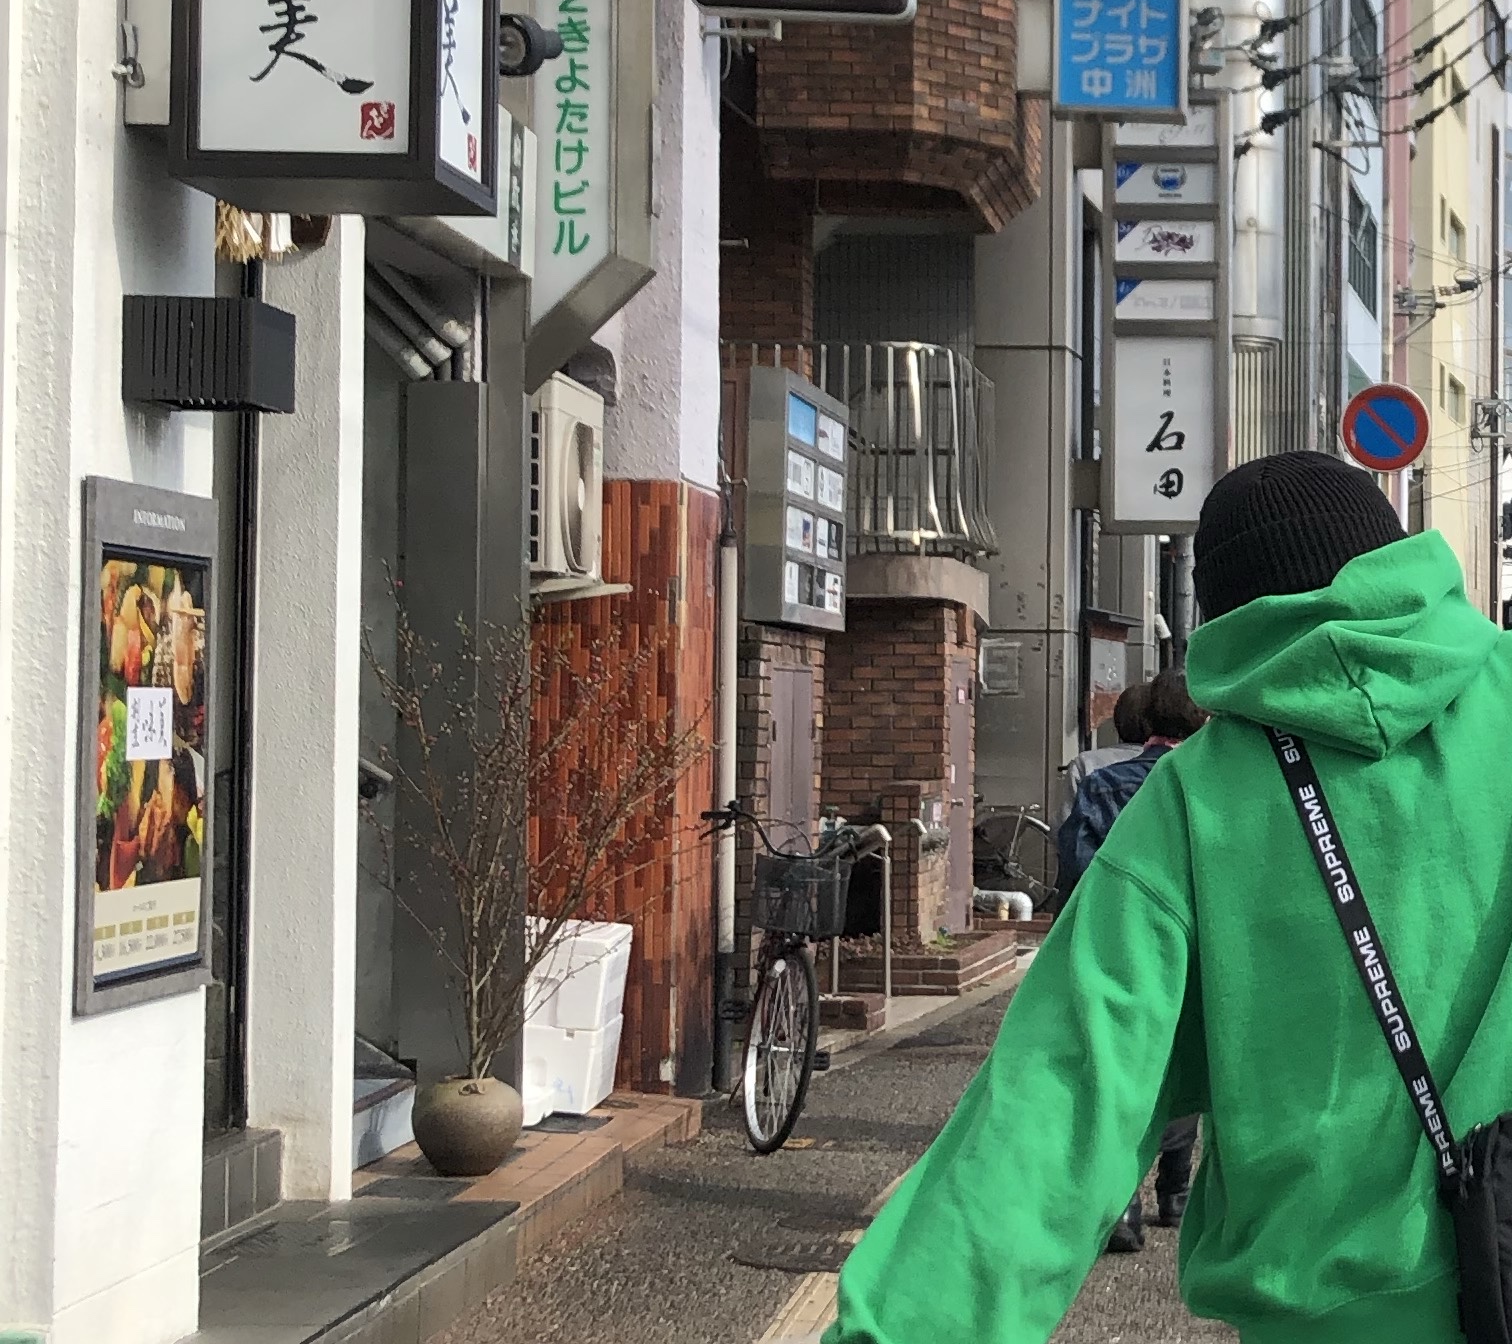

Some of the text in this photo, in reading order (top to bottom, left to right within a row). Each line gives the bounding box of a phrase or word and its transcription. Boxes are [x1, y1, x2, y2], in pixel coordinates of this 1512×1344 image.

[1081, 67, 1158, 99] 中洲
[1145, 410, 1186, 500] 石田
[133, 508, 186, 531] INFORMATION
[1298, 784, 1356, 904] SUPREME
[1353, 926, 1413, 1053] SUPREME
